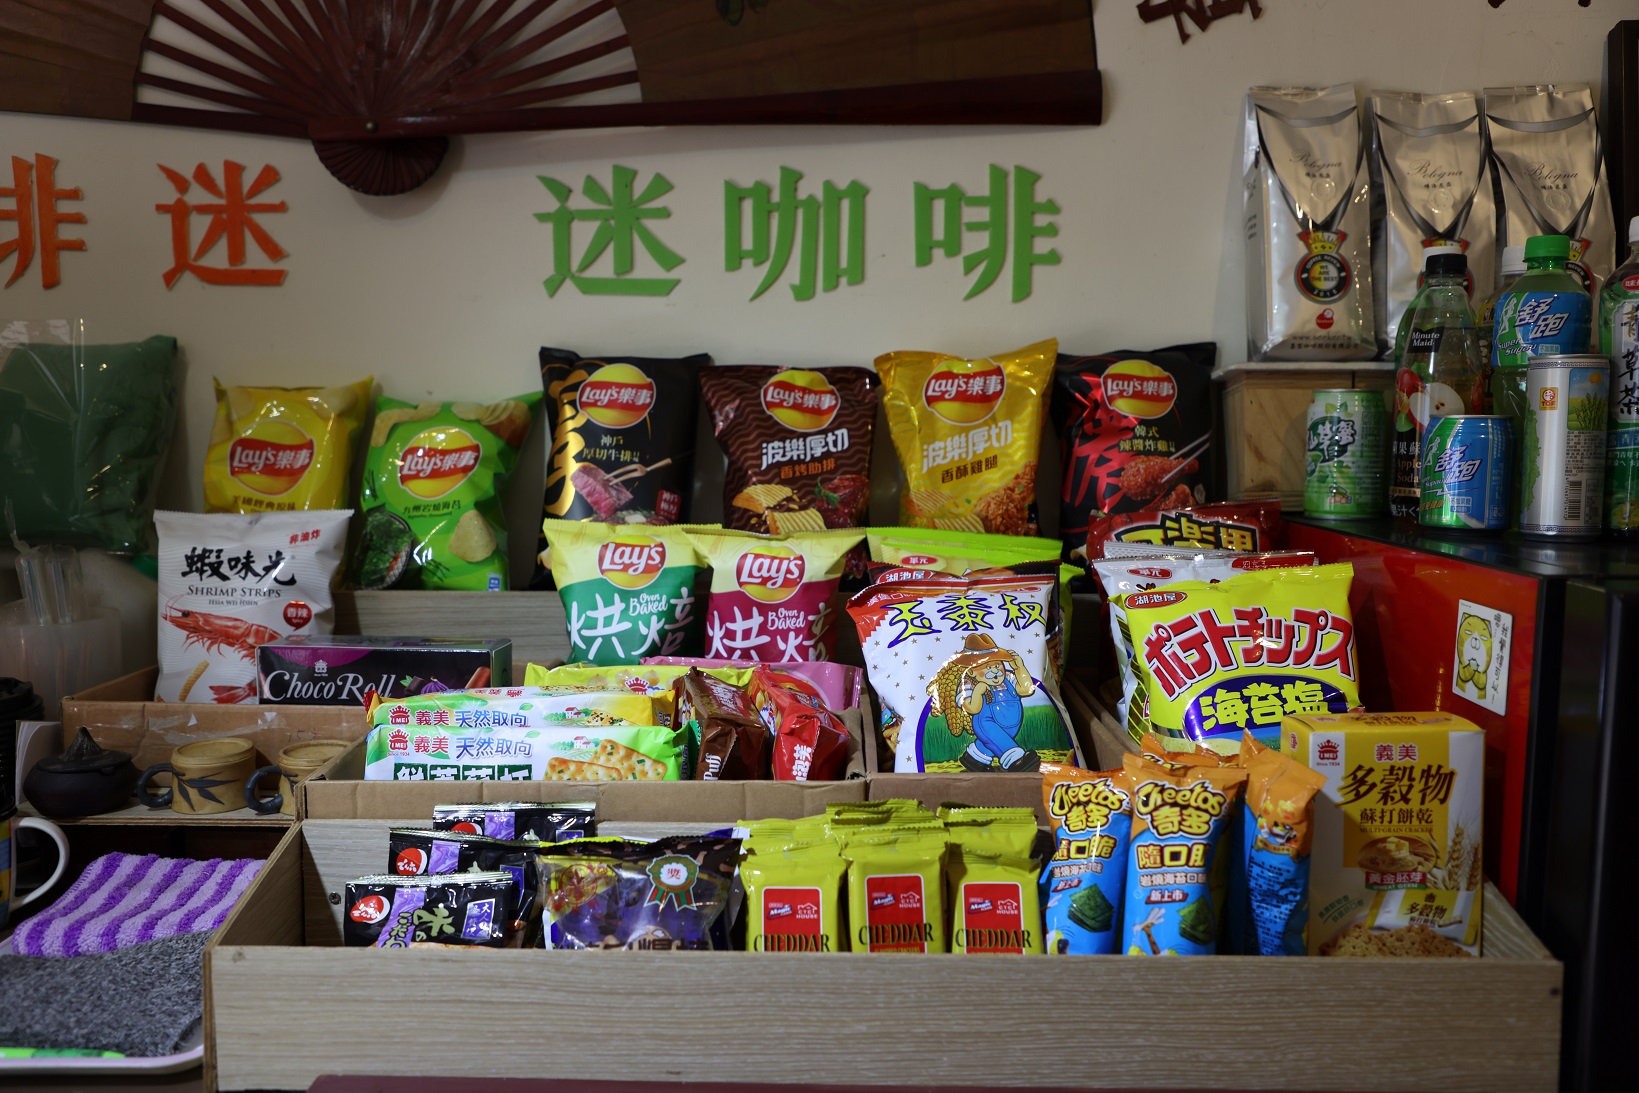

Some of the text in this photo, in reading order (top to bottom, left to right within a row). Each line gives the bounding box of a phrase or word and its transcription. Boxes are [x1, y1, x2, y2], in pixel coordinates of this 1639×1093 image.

[1407, 158, 1464, 183] Bologna
[1524, 161, 1579, 181] Bologna
[155, 159, 289, 290] 迷
[533, 164, 1062, 303] 迷咖啡
[1514, 297, 1570, 339] 舒跑
[1412, 331, 1440, 340] Minute
[1412, 339, 1434, 347] Maid
[581, 385, 653, 406] Lay's 樂事
[765, 384, 837, 410] Lay's 樂事
[926, 374, 1004, 400] Lay's 樂事
[1106, 377, 1175, 398] Lay's 樂事
[1134, 424, 1160, 438] 韓式
[761, 428, 849, 470] 波樂厚切
[921, 420, 1013, 474] 波樂厚切
[233, 446, 313, 477] Lay's 樂事
[401, 449, 480, 478] Lay's 樂事
[780, 457, 837, 479] 香烤肋排
[941, 454, 999, 484] 香酥雞腿
[1433, 444, 1483, 484] 舒跑
[289, 529, 321, 545] 非油炸
[181, 546, 297, 586] 蝦味先
[601, 542, 664, 575] Lay's
[739, 554, 802, 588] Lay's
[629, 596, 668, 617] Baked
[639, 593, 661, 603] Oven
[1134, 591, 1178, 605] 湖池屋
[286, 606, 309, 618] 香辣
[767, 610, 806, 631] Baked
[778, 607, 799, 618] Oven
[1142, 606, 1357, 702] ポテトチップス
[265, 670, 397, 704] Choco Roll
[415, 710, 450, 726] 義美
[454, 709, 528, 727] 天然取向
[1199, 681, 1329, 731] 海苔塩
[413, 735, 450, 754] 義美
[455, 737, 533, 760] 天然取向
[1375, 743, 1419, 762] 義美
[703, 753, 722, 780] Puff
[1336, 763, 1455, 806] 多穀物
[1052, 780, 1125, 817] Cheetos
[1136, 780, 1227, 819] Cheetos
[1065, 803, 1110, 832] 奇多
[1151, 805, 1210, 835] 奇多
[1359, 807, 1434, 825] 蘇打餅乾
[1367, 871, 1424, 885] 黃金胚芽
[1149, 889, 1184, 902] 新上市
[753, 934, 830, 952] CHEDDAR
[858, 922, 934, 946] CHEDDAR
[955, 928, 1032, 949] CHEDDAR
